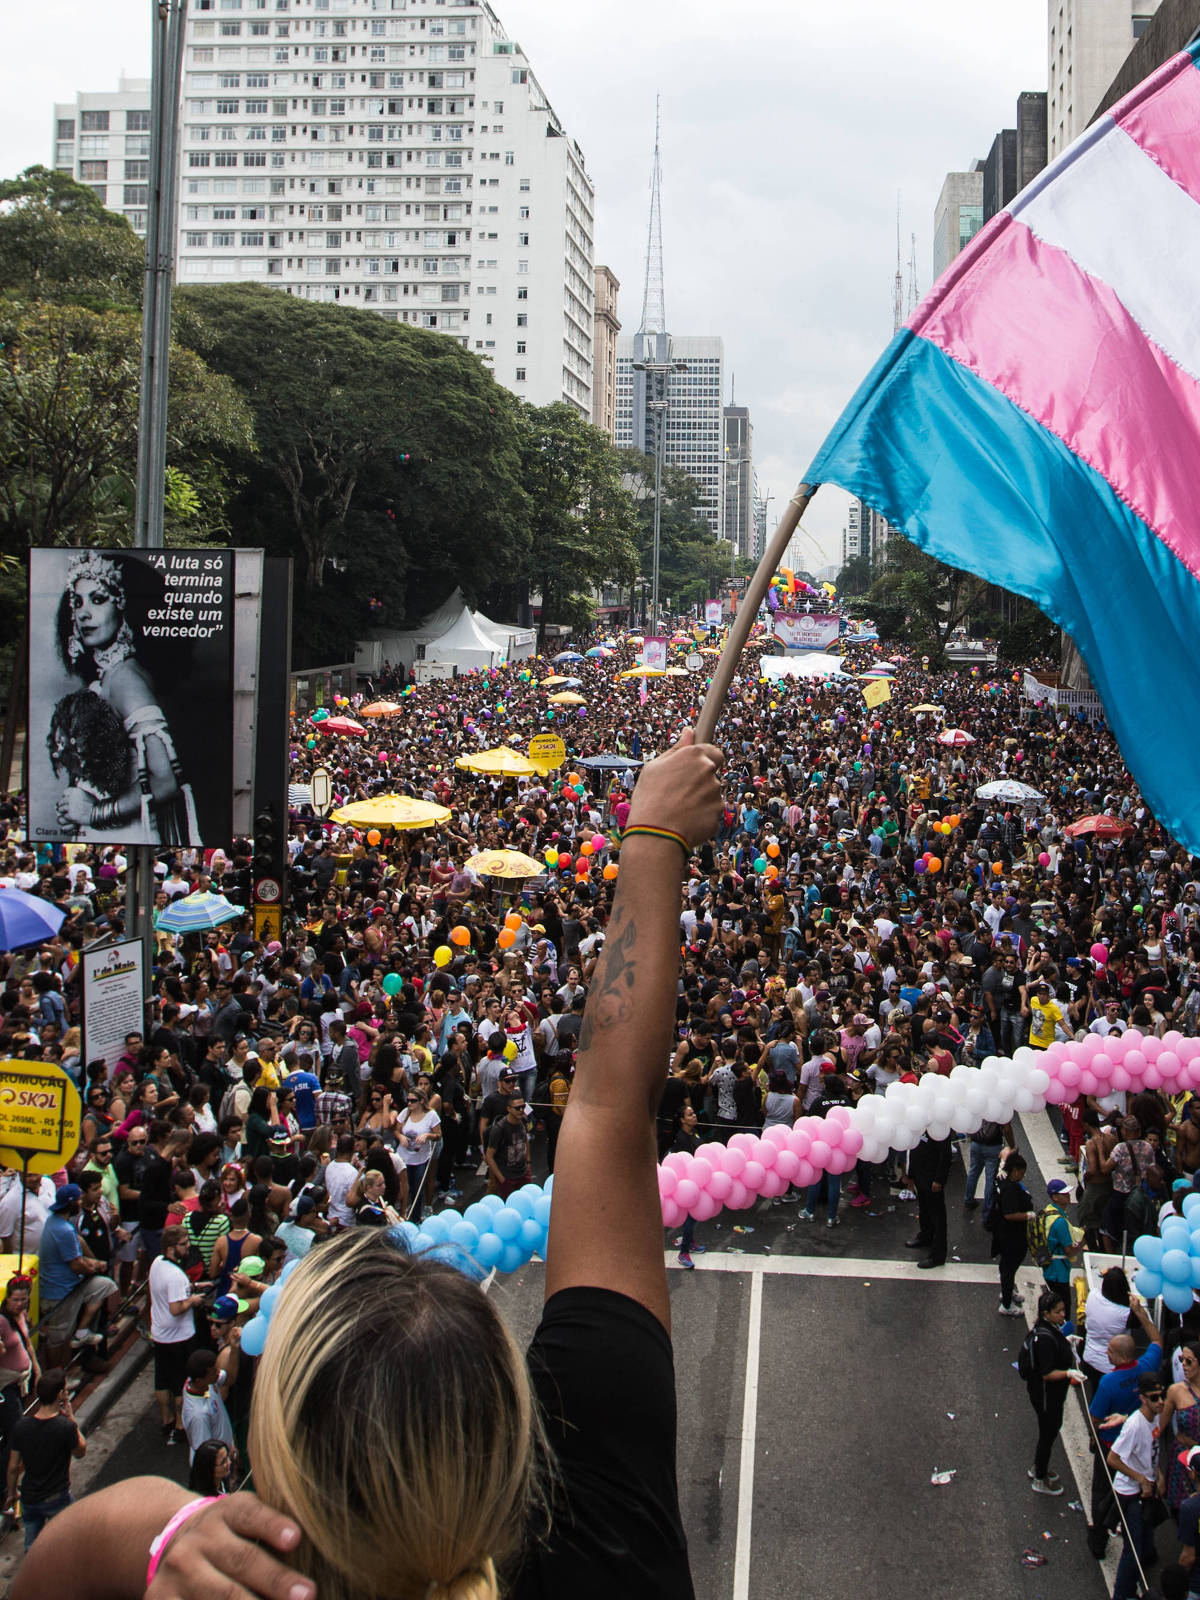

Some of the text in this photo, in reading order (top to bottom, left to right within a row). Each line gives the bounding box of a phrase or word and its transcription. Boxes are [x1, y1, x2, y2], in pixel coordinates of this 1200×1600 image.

[148, 555, 223, 570] “A luta só
[164, 573, 223, 587] termina
[164, 590, 223, 606] quando
[147, 606, 223, 621] existe um
[142, 624, 224, 638] vencedor”
[35, 827, 58, 836] Clara
[0, 1074, 64, 1088] ROMOÇÃO
[18, 1091, 57, 1109] SKOL
[44, 1118, 55, 1126] R$
[41, 1128, 52, 1137] R$
